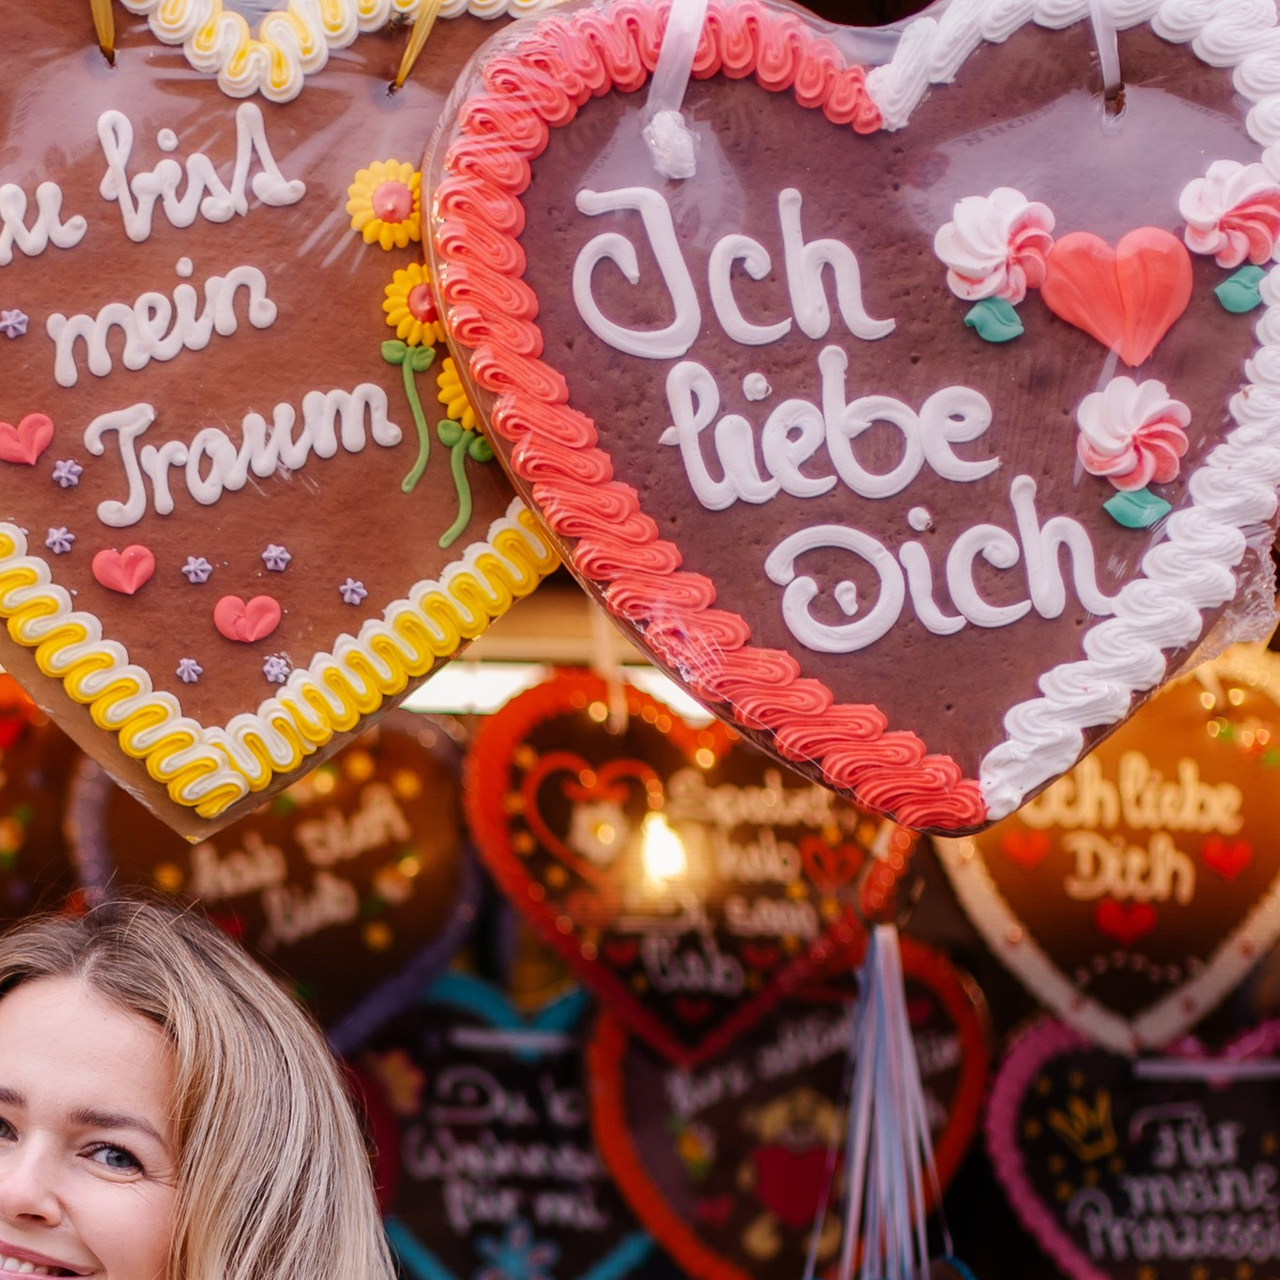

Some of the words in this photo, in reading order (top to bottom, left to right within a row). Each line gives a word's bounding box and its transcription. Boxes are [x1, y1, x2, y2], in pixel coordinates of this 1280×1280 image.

[97, 102, 306, 242] bist
[46, 257, 277, 386] mein
[573, 187, 896, 359] Ich
[84, 383, 402, 527] Traum
[658, 345, 1001, 510] liebe
[765, 474, 1113, 653] Dich
[1118, 750, 1246, 836] liebe
[1061, 831, 1196, 906] Dich
